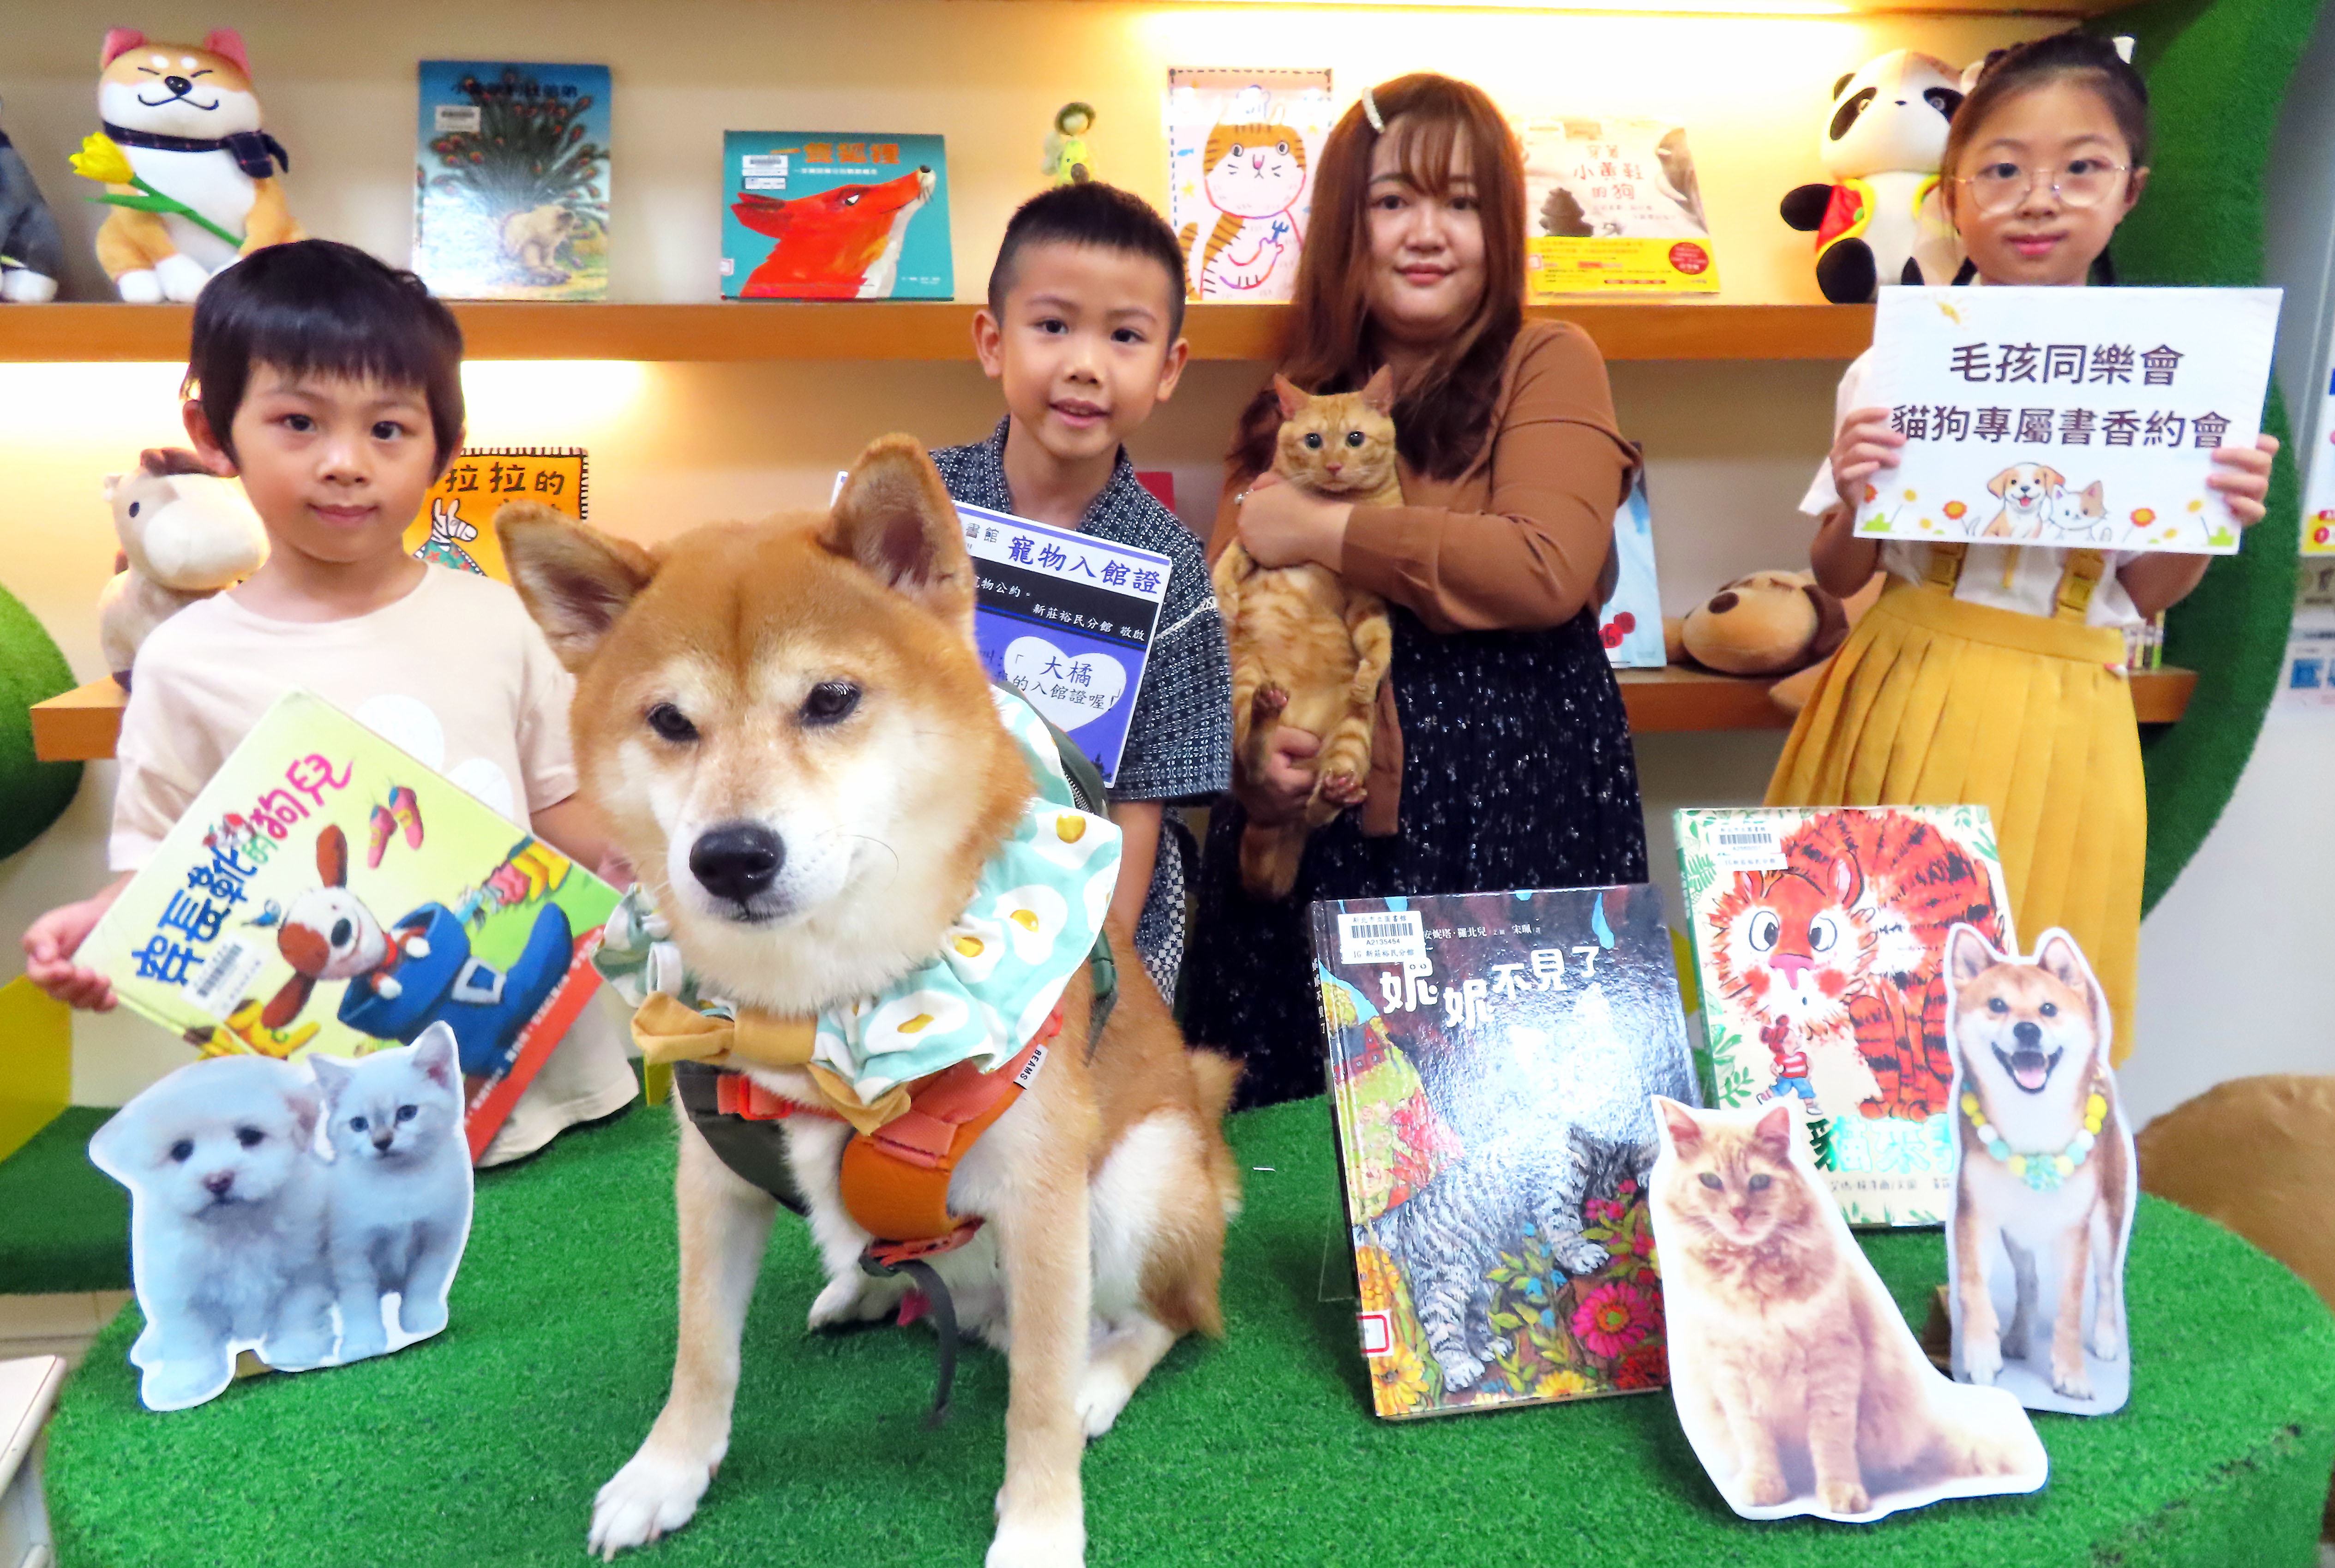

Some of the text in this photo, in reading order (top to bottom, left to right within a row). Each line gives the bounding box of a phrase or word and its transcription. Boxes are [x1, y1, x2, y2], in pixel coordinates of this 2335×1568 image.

[1950, 342, 2185, 386] 毛孩同樂會
[1891, 404, 2232, 449] 貓狗專屬書香約會
[445, 461, 565, 495] 拉拉的
[1008, 535, 1161, 594] 寵物入館證
[1032, 603, 1145, 641] 新莊裕民分館 敬啟
[1380, 946, 1600, 1030] 妮妮不見了
[1020, 1049, 1042, 1080] BEAMS
